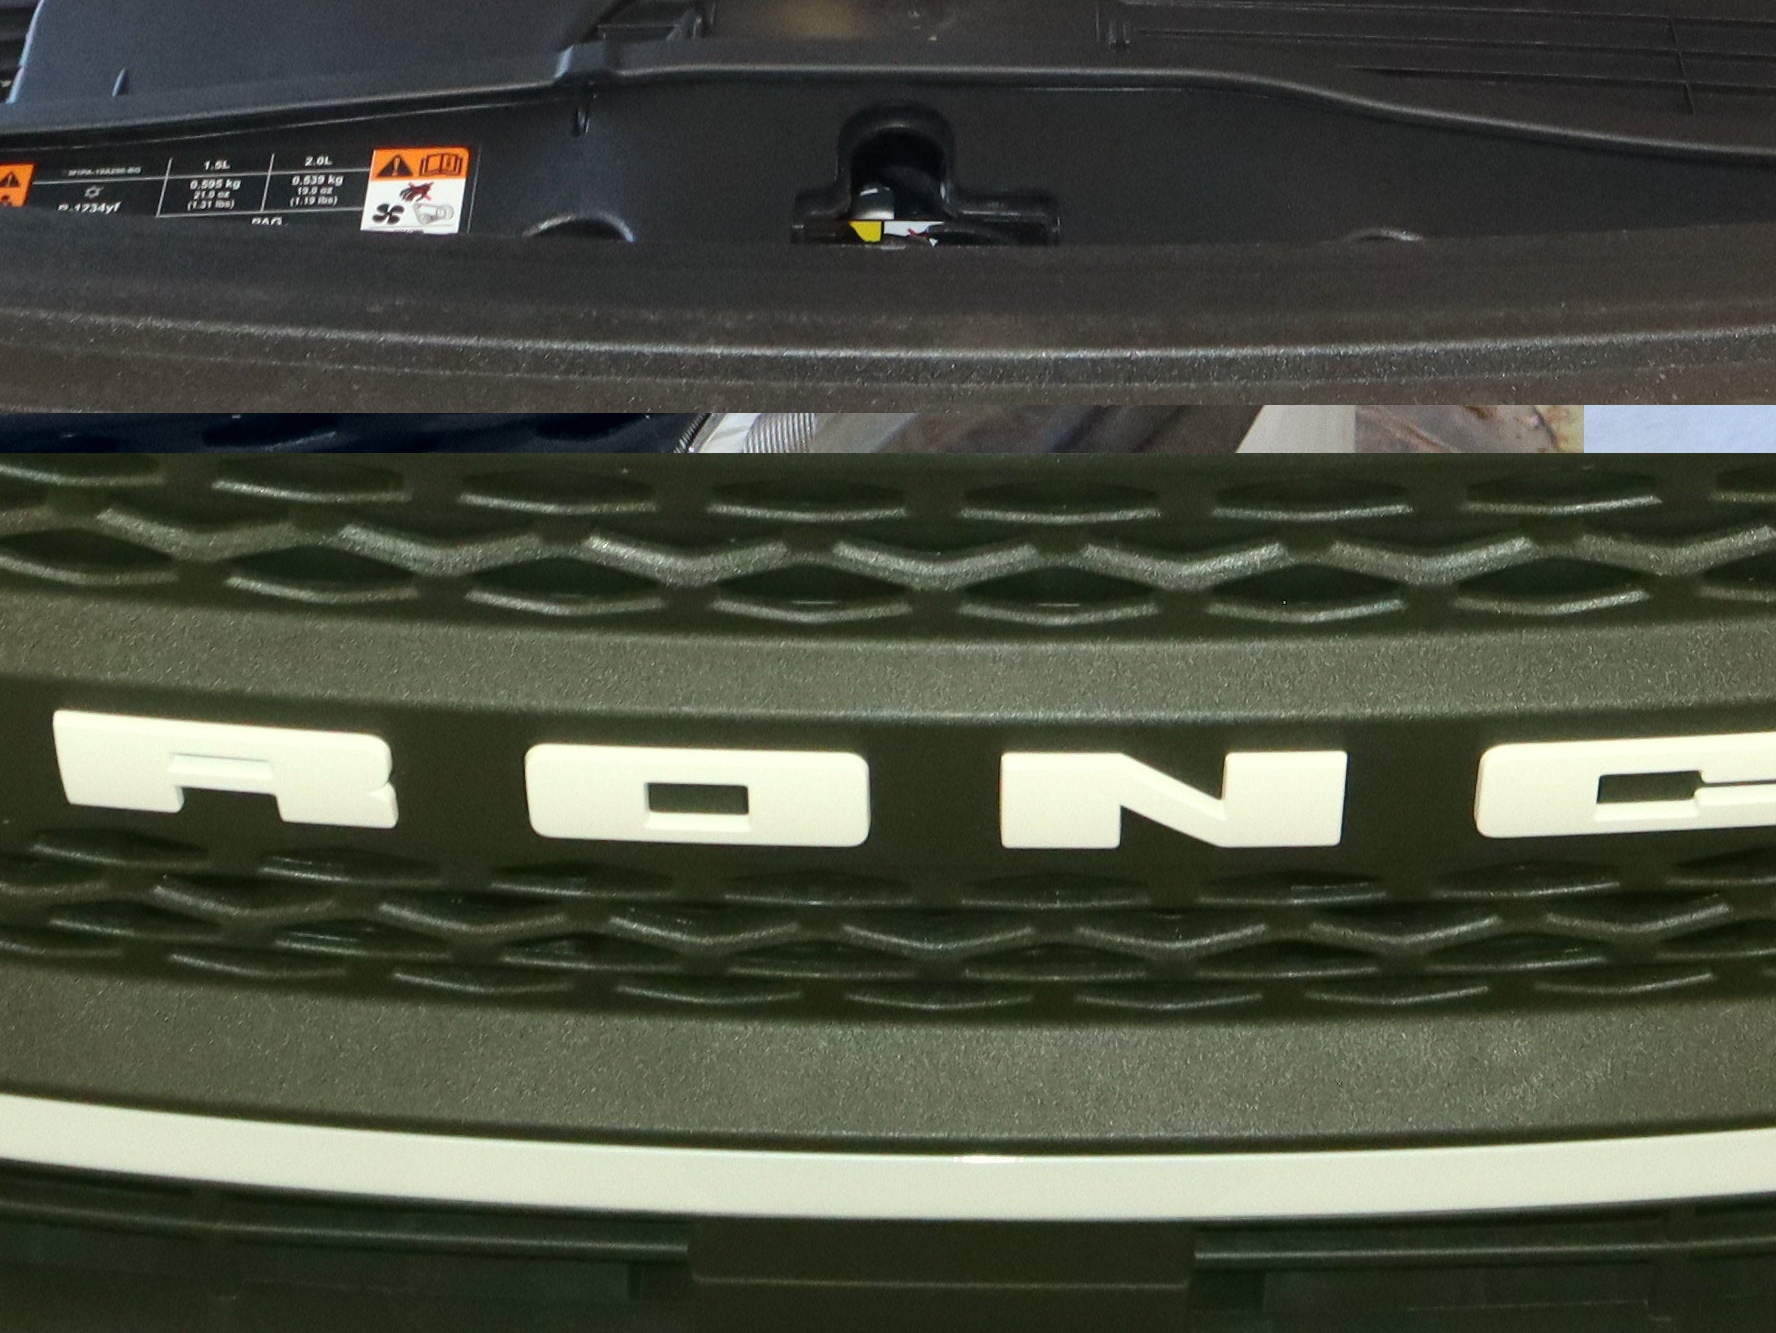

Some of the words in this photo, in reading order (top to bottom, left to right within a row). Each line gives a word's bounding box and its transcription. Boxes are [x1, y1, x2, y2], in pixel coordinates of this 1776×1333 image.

[304, 155, 333, 167] 2.0L
[225, 178, 242, 191] kg
[327, 174, 344, 187] kg
[217, 190, 231, 198] oz
[320, 186, 333, 195] oz
